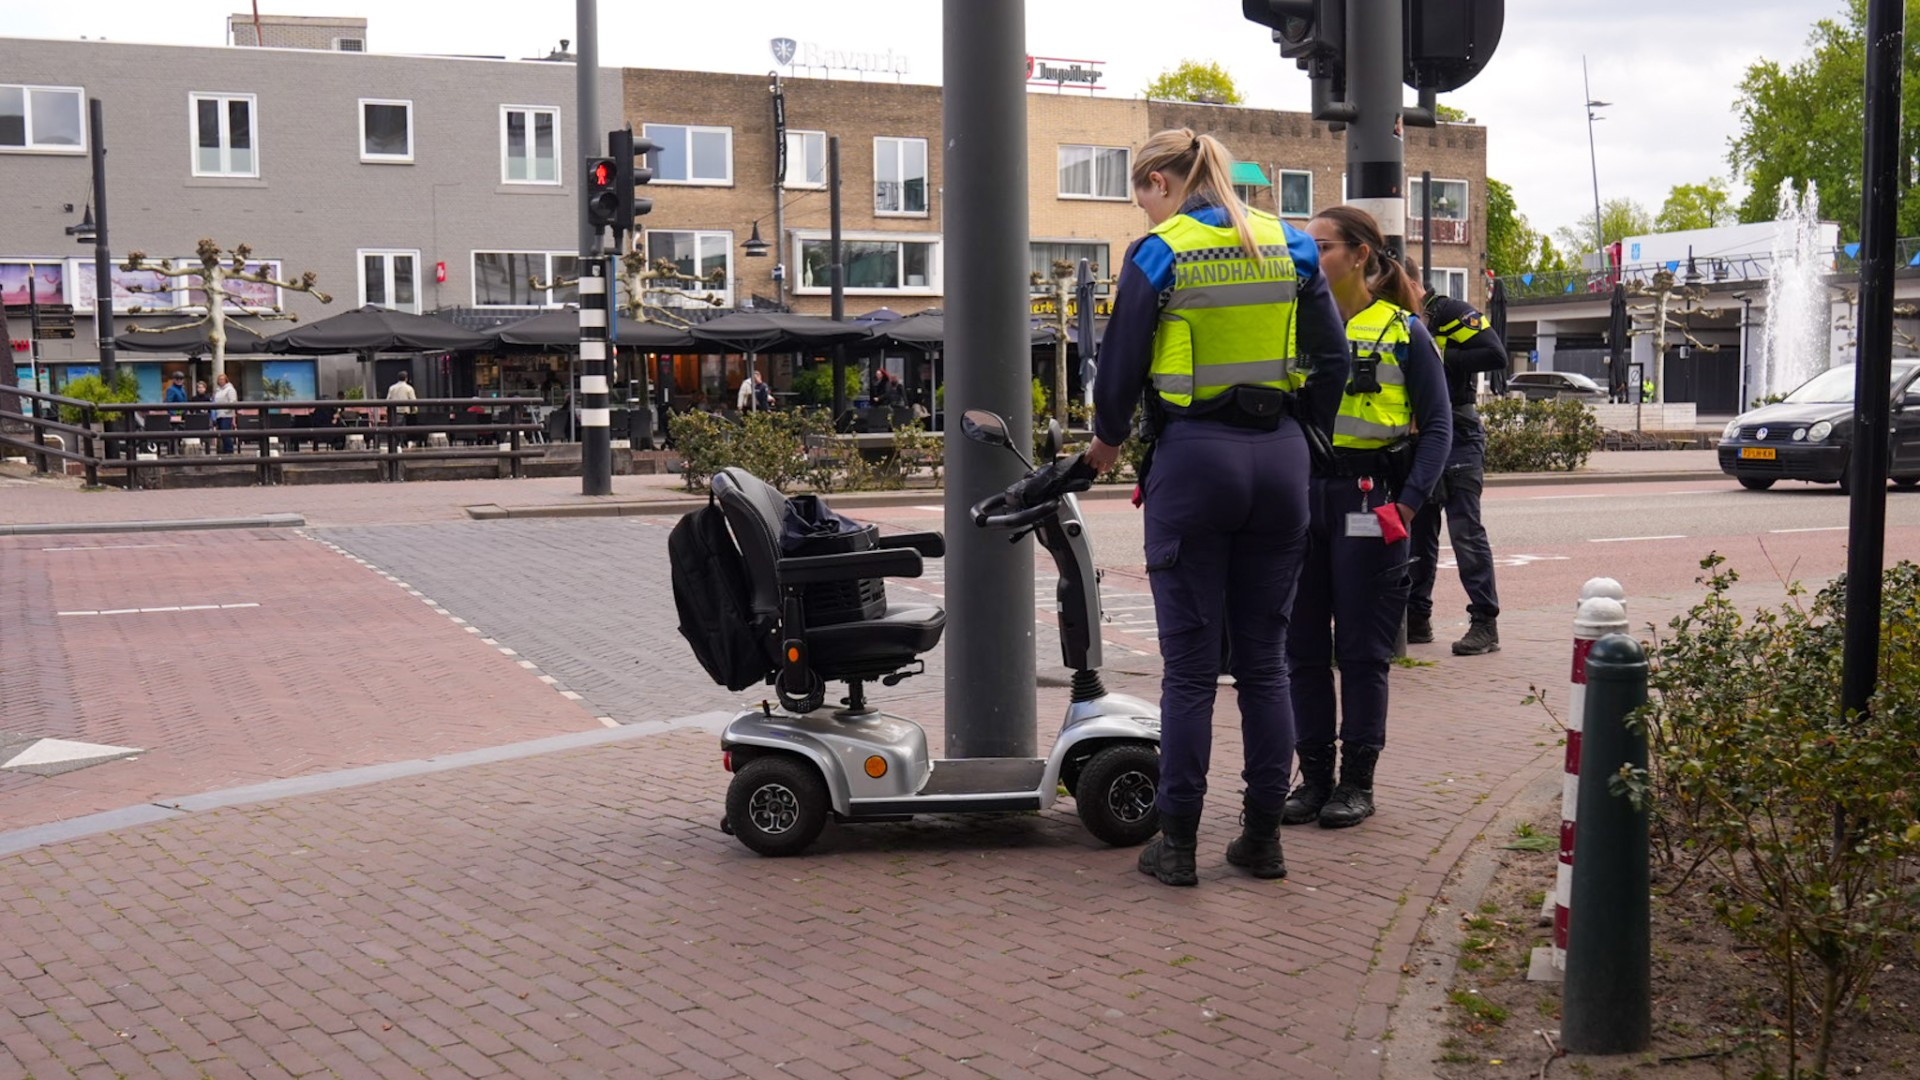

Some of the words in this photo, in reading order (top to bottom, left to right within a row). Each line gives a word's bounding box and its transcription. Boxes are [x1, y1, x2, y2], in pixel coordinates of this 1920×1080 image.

[802, 41, 909, 74] Bavaria
[1032, 62, 1103, 84] Jupiler
[1177, 259, 1295, 285] HANDHAVING
